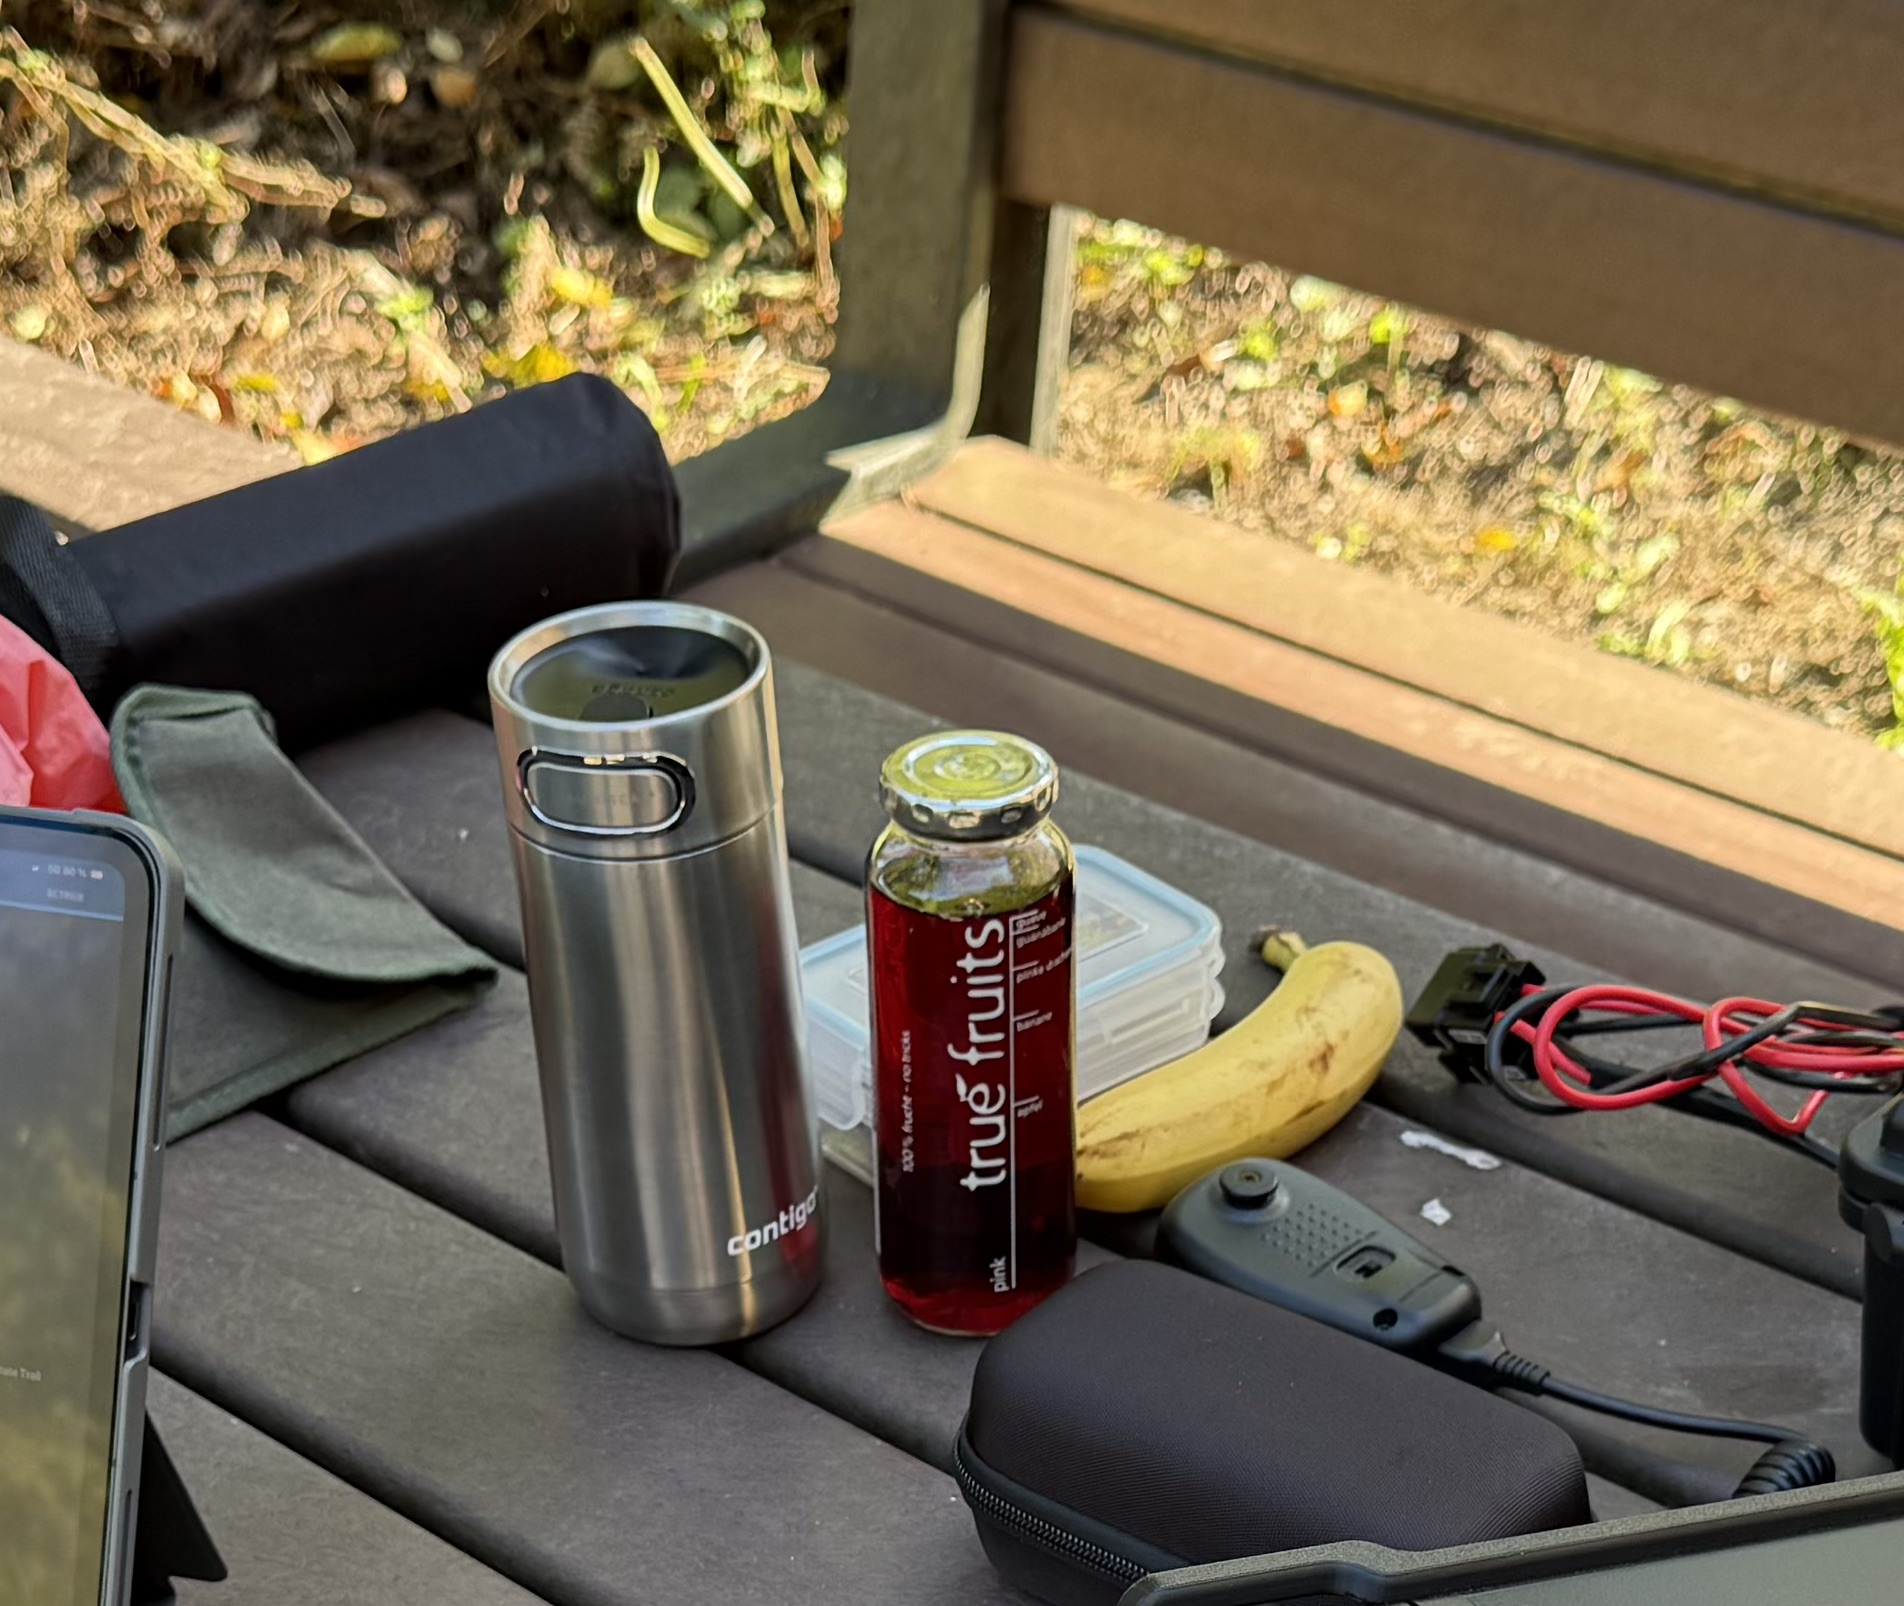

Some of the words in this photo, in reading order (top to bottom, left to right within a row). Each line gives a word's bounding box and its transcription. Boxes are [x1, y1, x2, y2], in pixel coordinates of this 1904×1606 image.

[947, 919, 1006, 1066] fruits
[957, 1076, 1007, 1193] true
[727, 1191, 817, 1257] contigo
[989, 1256, 1010, 1293] pink
